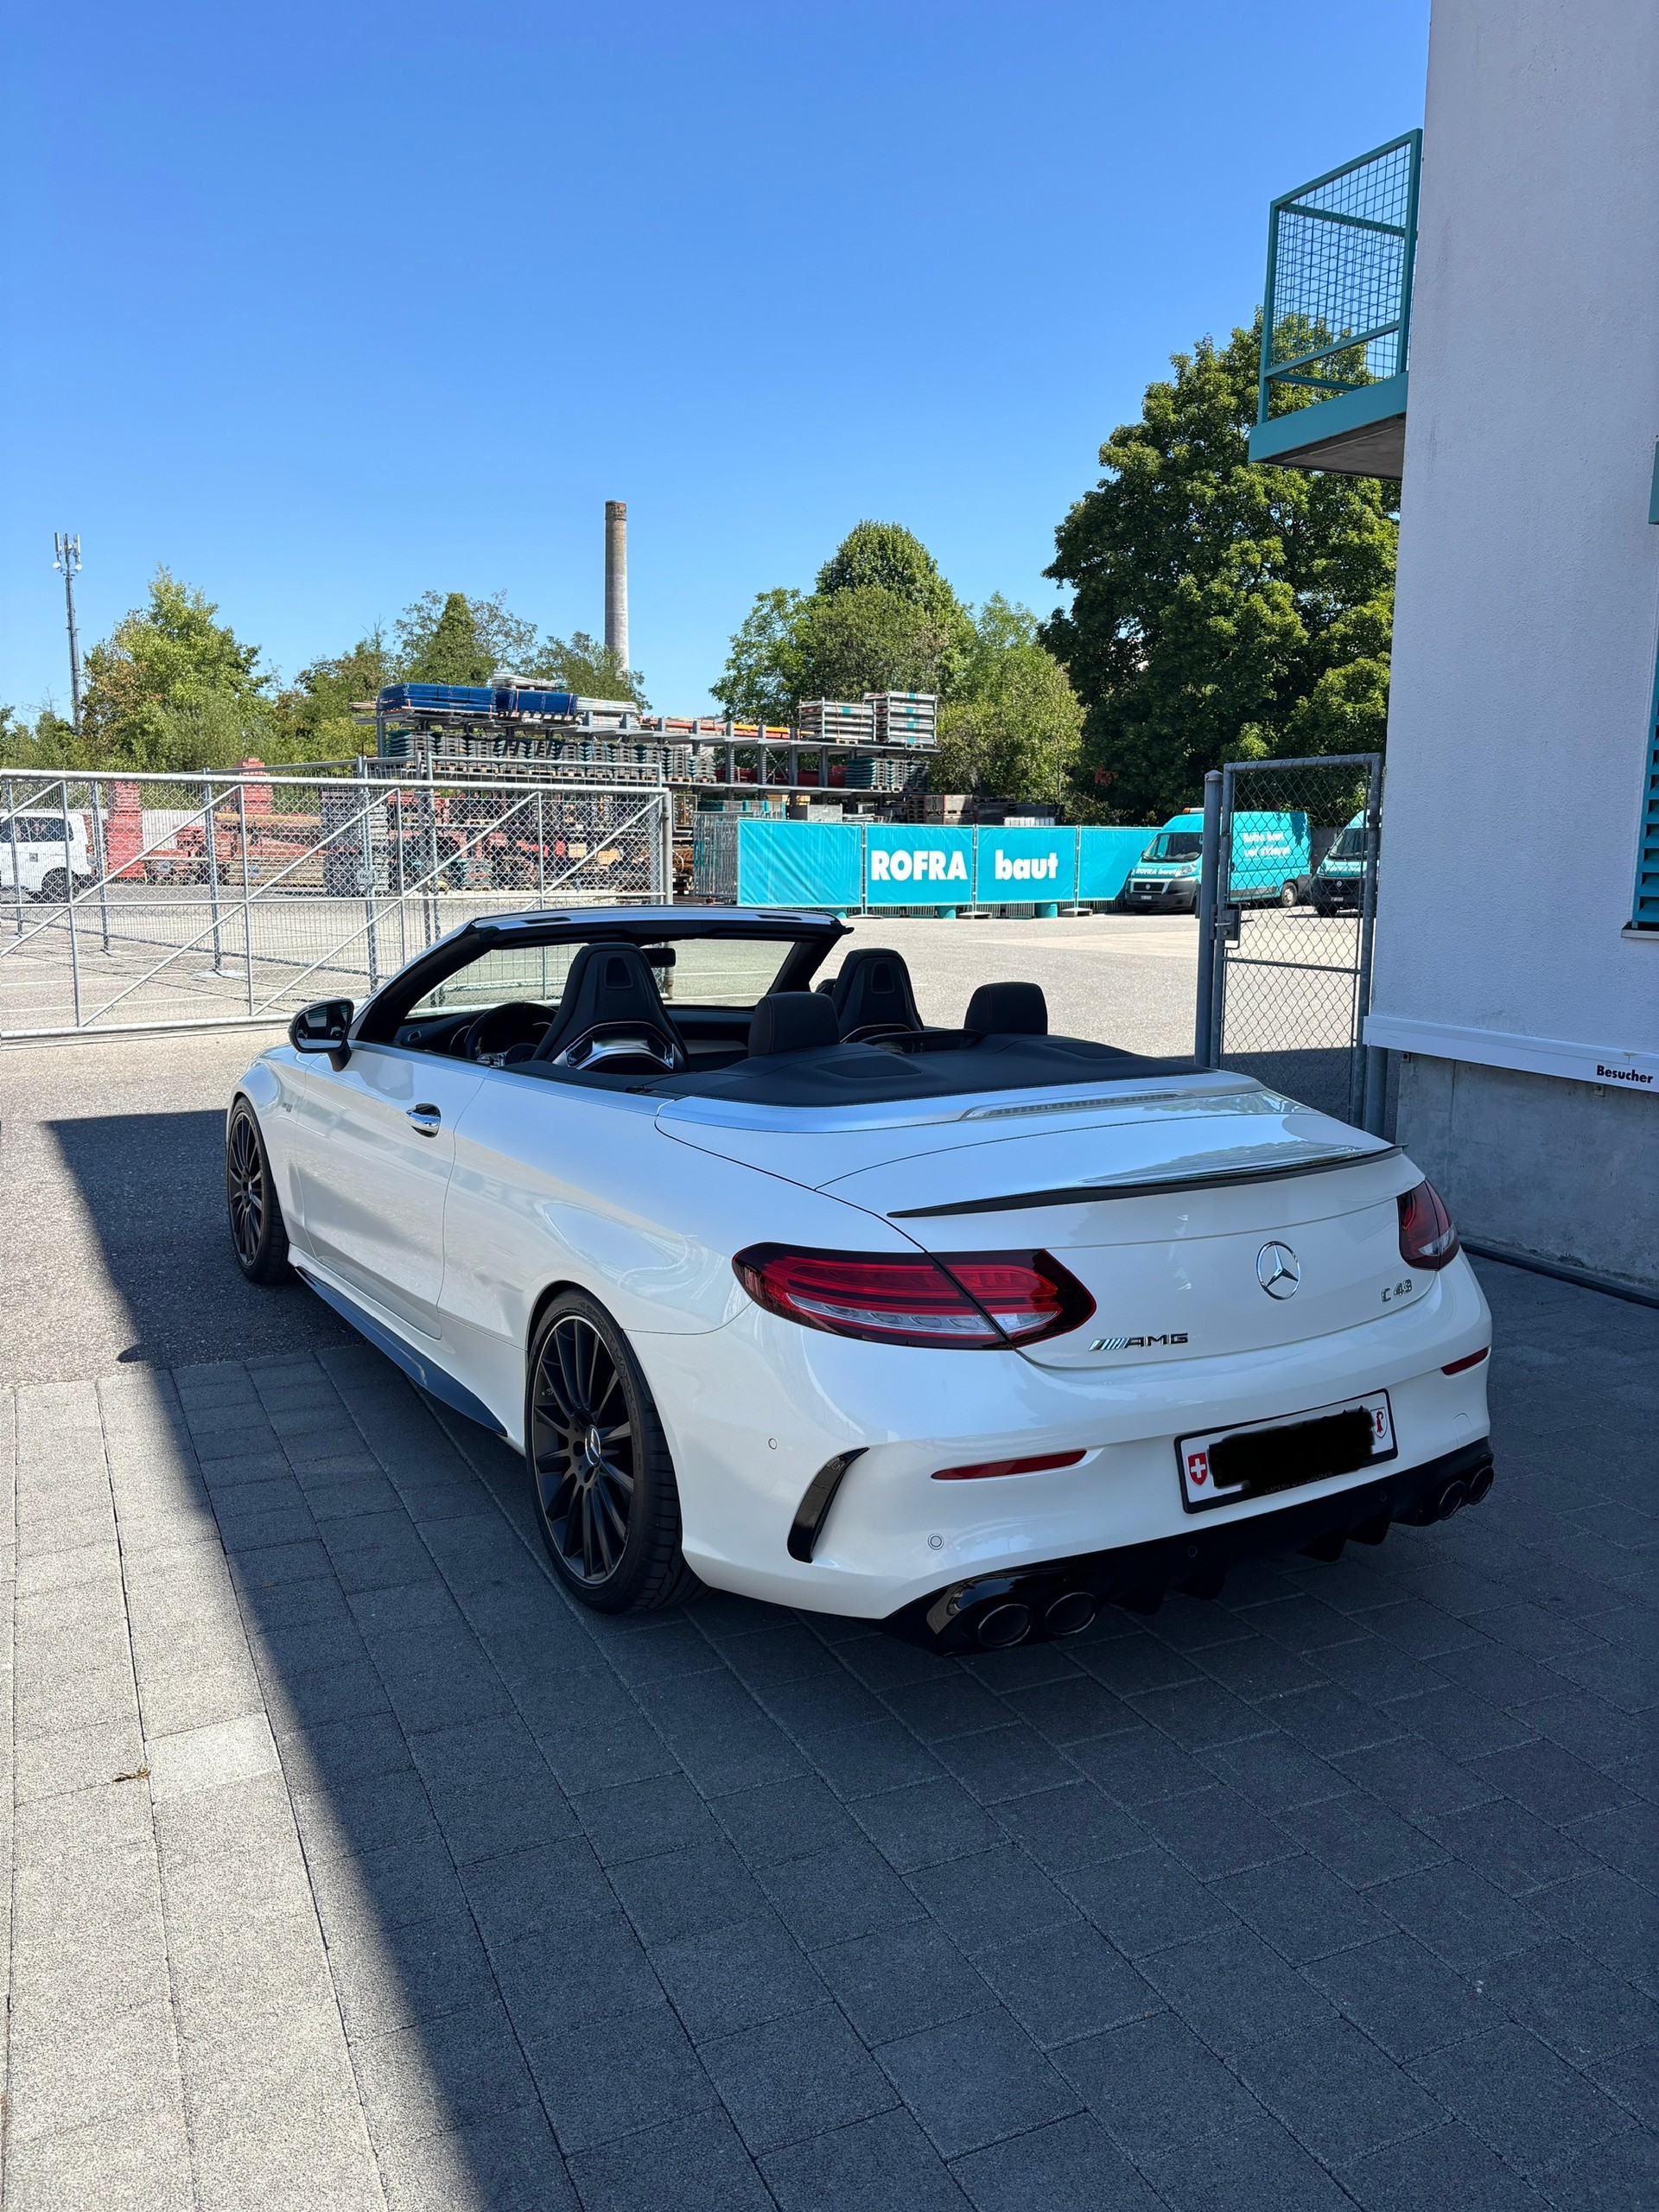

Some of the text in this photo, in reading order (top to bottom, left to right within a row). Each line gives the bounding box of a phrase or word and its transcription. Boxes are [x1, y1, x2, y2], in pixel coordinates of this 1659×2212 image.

[871, 849, 1058, 881] ROFRA baut
[1596, 1065, 1654, 1084] Besucher
[1381, 1279, 1413, 1302] C 43
[1122, 1332, 1189, 1350] AMG
